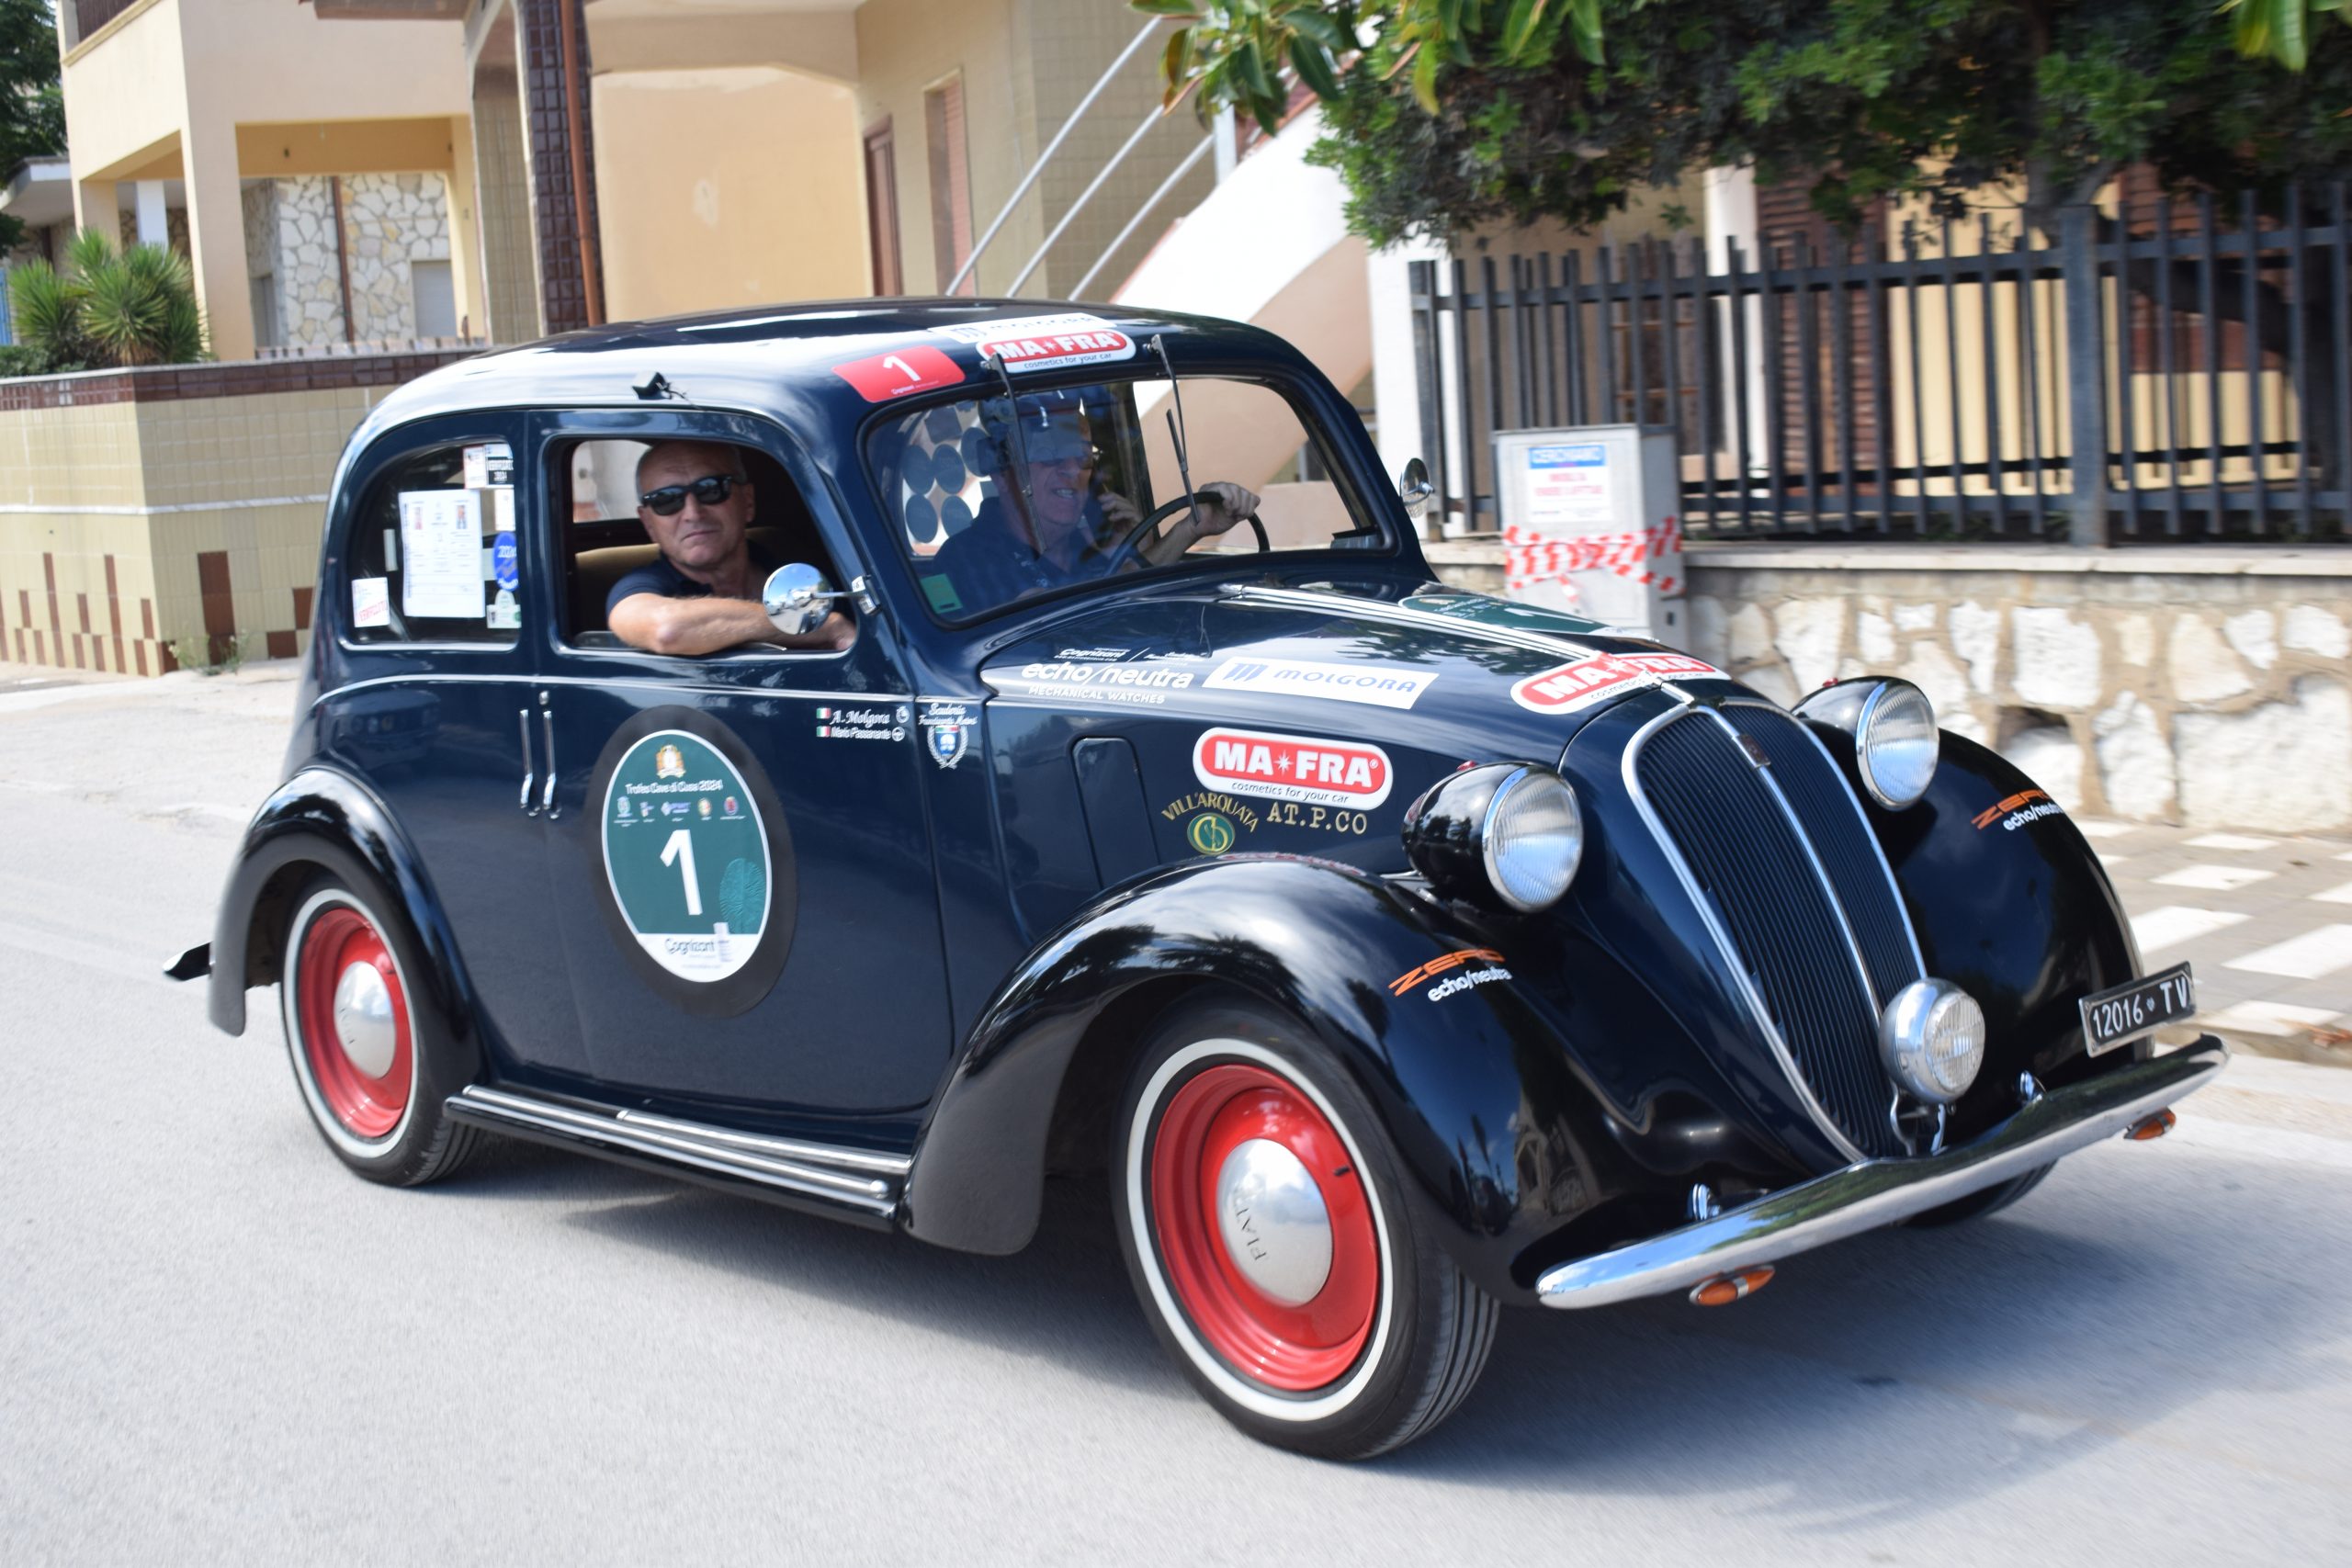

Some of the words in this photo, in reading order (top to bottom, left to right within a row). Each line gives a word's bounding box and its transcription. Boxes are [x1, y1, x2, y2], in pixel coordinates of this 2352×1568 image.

[882, 355, 922, 382] 1
[1023, 358, 1064, 369] cosmetics
[1065, 355, 1077, 365] for
[1079, 355, 1097, 366] your
[1100, 352, 1112, 360] car
[1021, 660, 1195, 689] echo/neutra
[1028, 685, 1103, 701] MECHANICAL
[1107, 691, 1166, 705] WATCHES
[845, 708, 890, 728] Molgora
[698, 778, 724, 792] 2024
[1231, 781, 1283, 796] cosmetics
[1285, 785, 1302, 798] for
[1304, 790, 1329, 805] your
[1331, 793, 1350, 804] car
[660, 829, 703, 916] 1
[1427, 965, 1513, 1002] echo/neutra
[2092, 994, 2144, 1039] 12016
[2159, 975, 2188, 1015] TV
